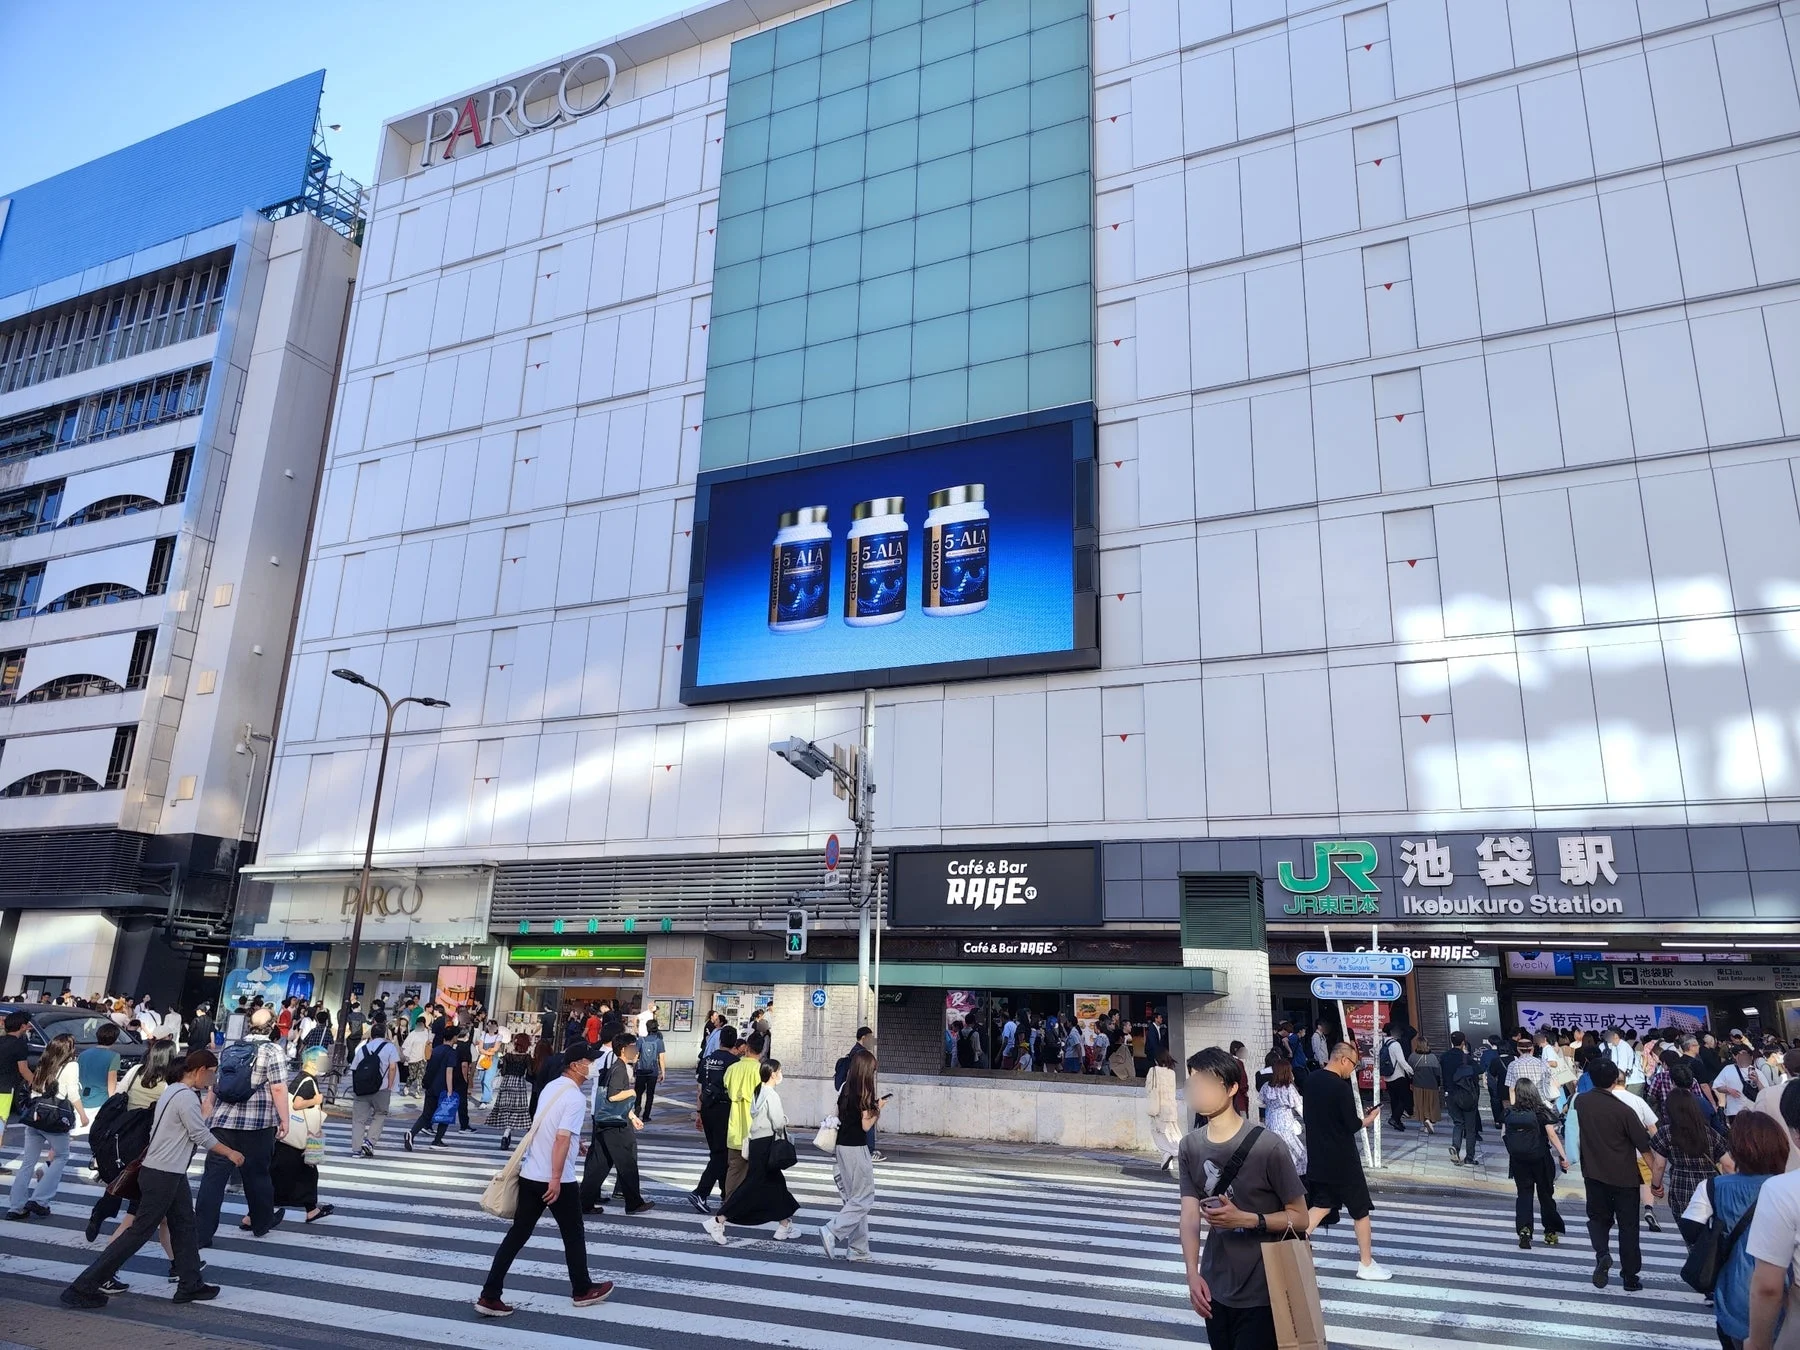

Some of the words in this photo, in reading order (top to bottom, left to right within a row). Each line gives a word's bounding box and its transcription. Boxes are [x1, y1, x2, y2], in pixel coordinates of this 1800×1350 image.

[421, 53, 616, 167] PARCO
[945, 529, 987, 550] 5-ALA
[782, 548, 824, 567] 5-ALA
[862, 541, 903, 562] 5-ALA
[947, 859, 984, 875] Café
[985, 861, 996, 874] &
[998, 859, 1028, 874] Bar
[1278, 841, 1382, 893] JR
[1400, 836, 1619, 888] 池袋駅
[946, 877, 1028, 911] RAGE
[1283, 894, 1380, 915] JR東日本
[1402, 895, 1525, 915] Ikebukuro
[1530, 893, 1624, 914] Station
[561, 948, 594, 958] NewDays
[963, 942, 989, 953] Café
[989, 944, 998, 953] &
[998, 943, 1019, 953] Bar
[1020, 942, 1054, 956] RAGE
[1402, 946, 1428, 959] Bar
[1429, 945, 1473, 963] RAGE
[1512, 961, 1549, 970] eyecity
[1582, 967, 1609, 980] JR
[1640, 967, 1674, 978] 池袋駅
[1640, 978, 1682, 986] Ikebukuro
[1683, 979, 1714, 987] Station
[813, 993, 825, 1003] 26
[1550, 1012, 1652, 1030] 帝京平成大学
